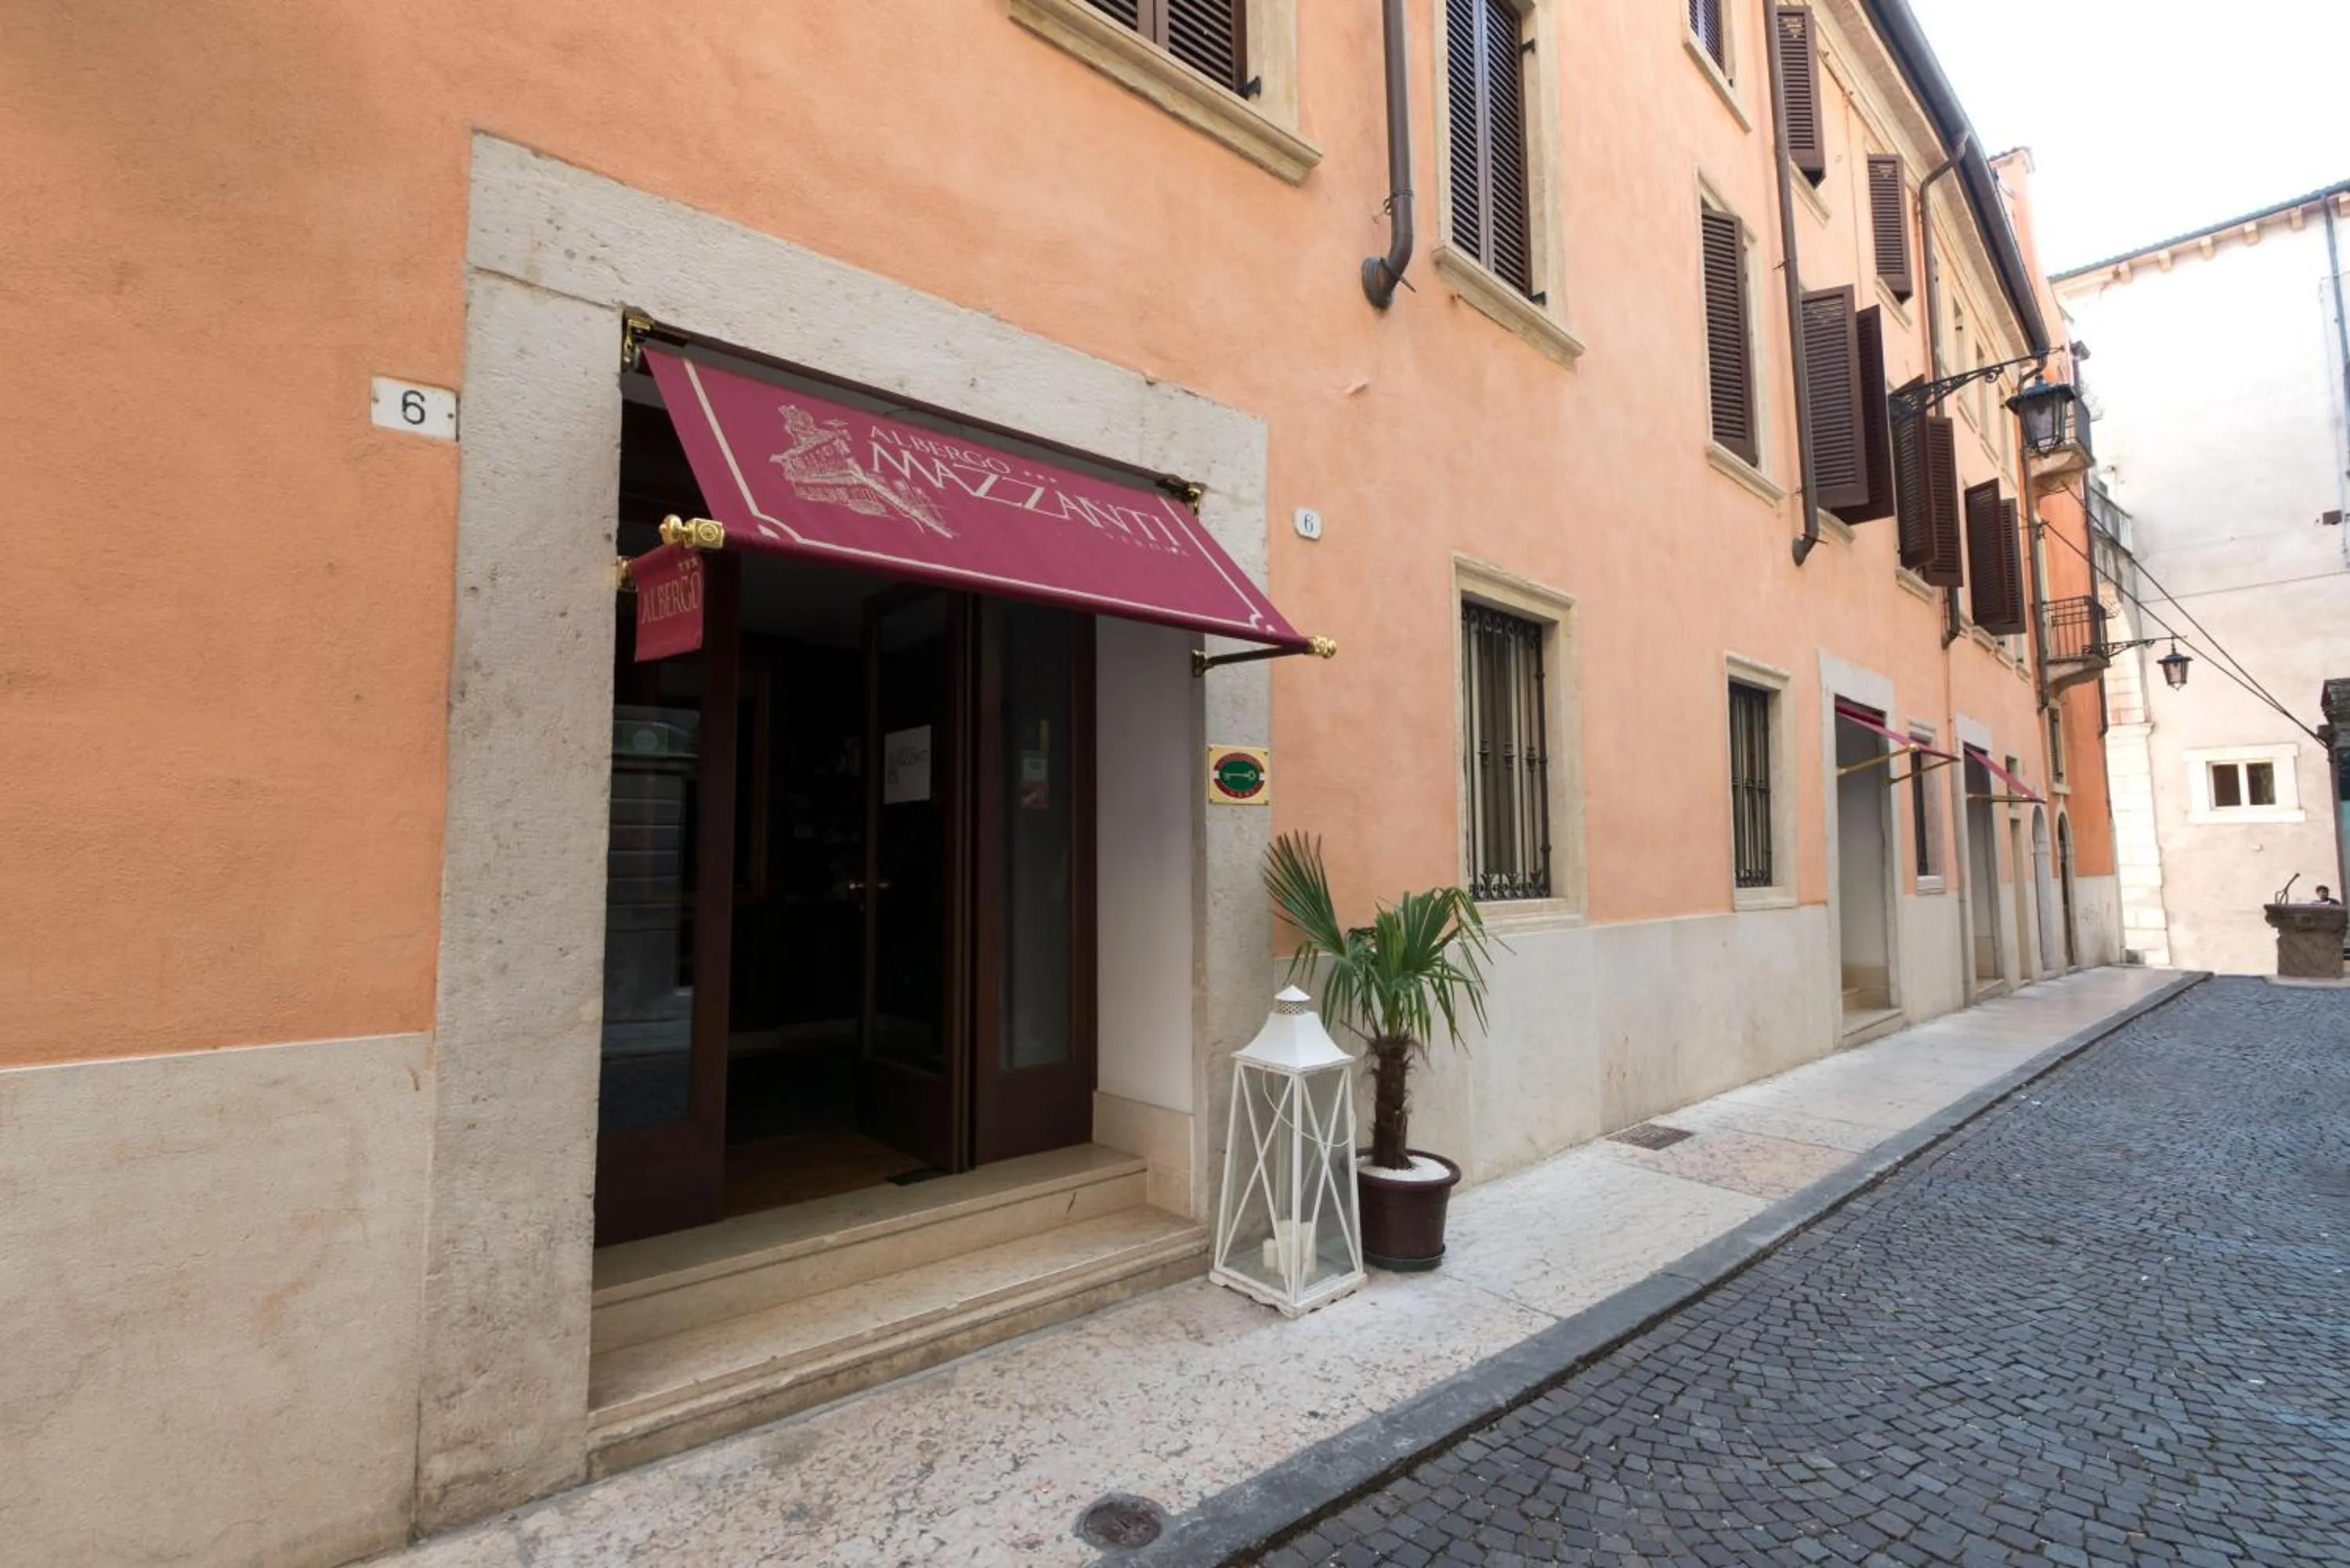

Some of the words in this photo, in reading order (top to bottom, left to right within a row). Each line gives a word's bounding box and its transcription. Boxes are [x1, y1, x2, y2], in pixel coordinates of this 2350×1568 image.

[401, 389, 425, 425] 6
[871, 425, 1010, 475] ALBERGO
[871, 441, 1181, 547] MAZZANTI
[1304, 513, 1314, 533] 6
[641, 572, 701, 625] ALBERGO
